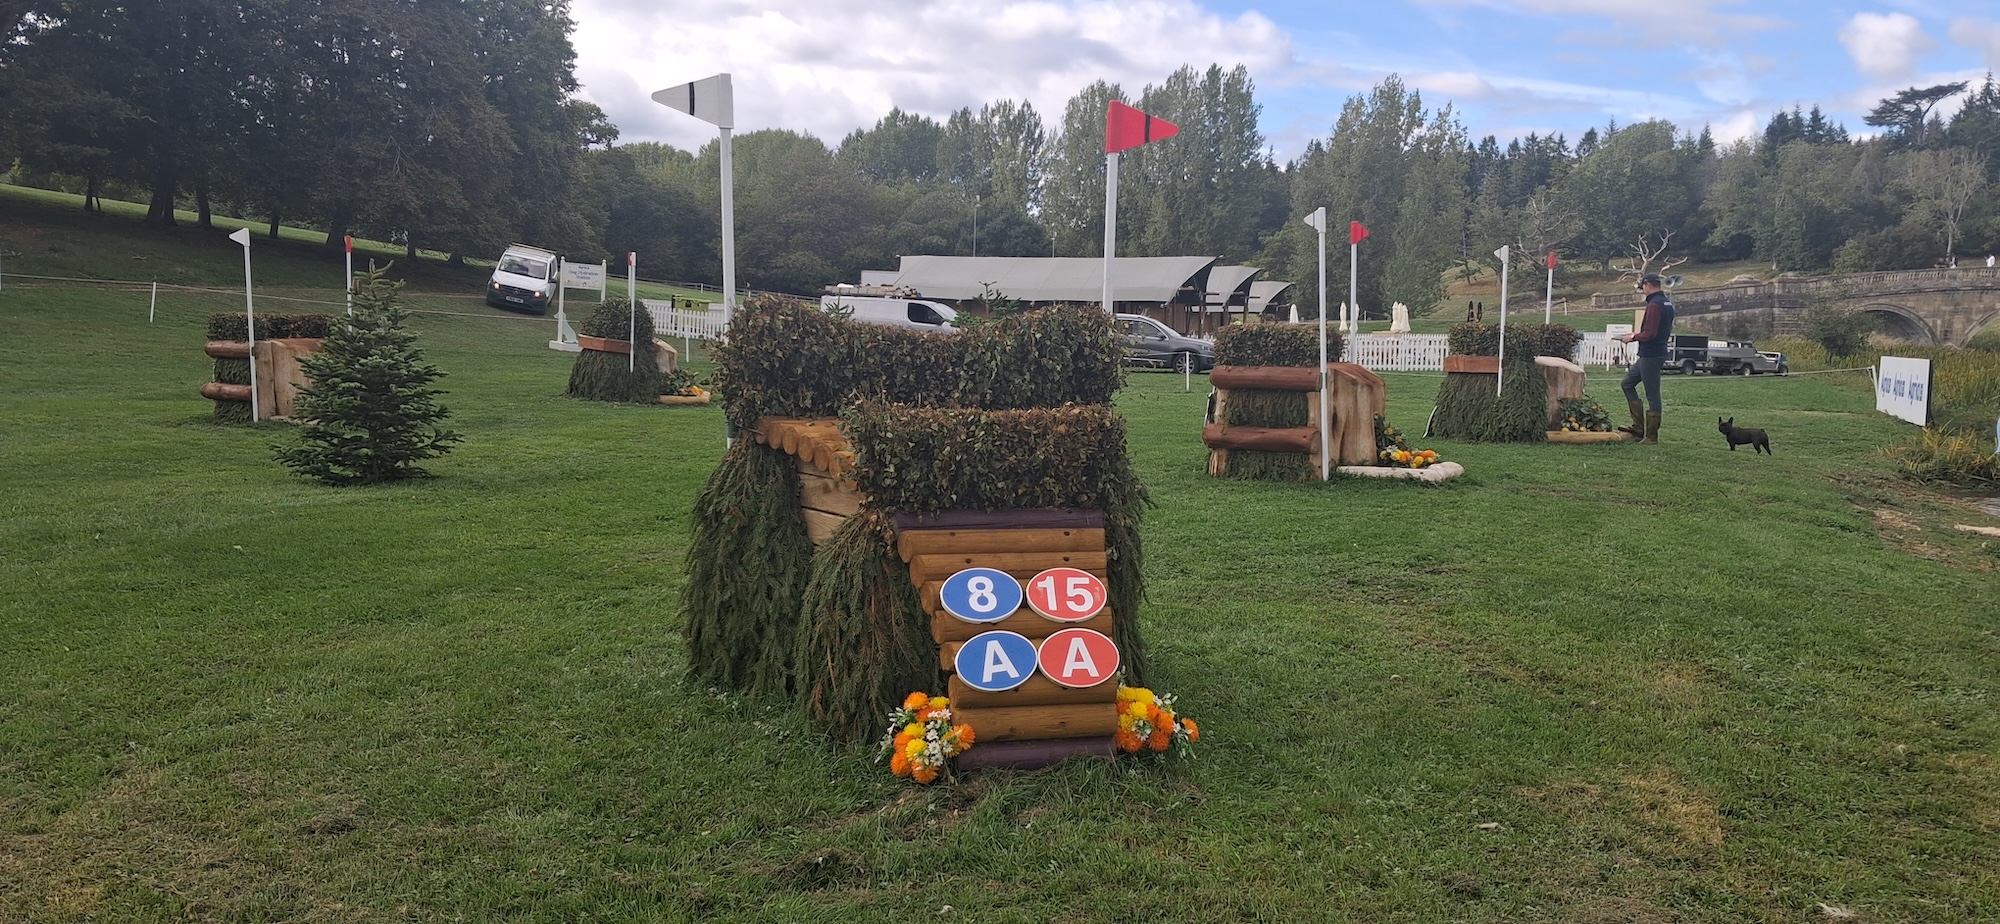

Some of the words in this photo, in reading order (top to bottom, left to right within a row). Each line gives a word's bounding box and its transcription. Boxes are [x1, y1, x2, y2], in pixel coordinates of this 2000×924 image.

[1893, 371, 1906, 402] Agria
[1908, 373, 1923, 406] Agria
[967, 576, 998, 613] 8
[1037, 575, 1094, 612] 15
[982, 639, 1021, 683] A
[1062, 637, 1100, 678] A
